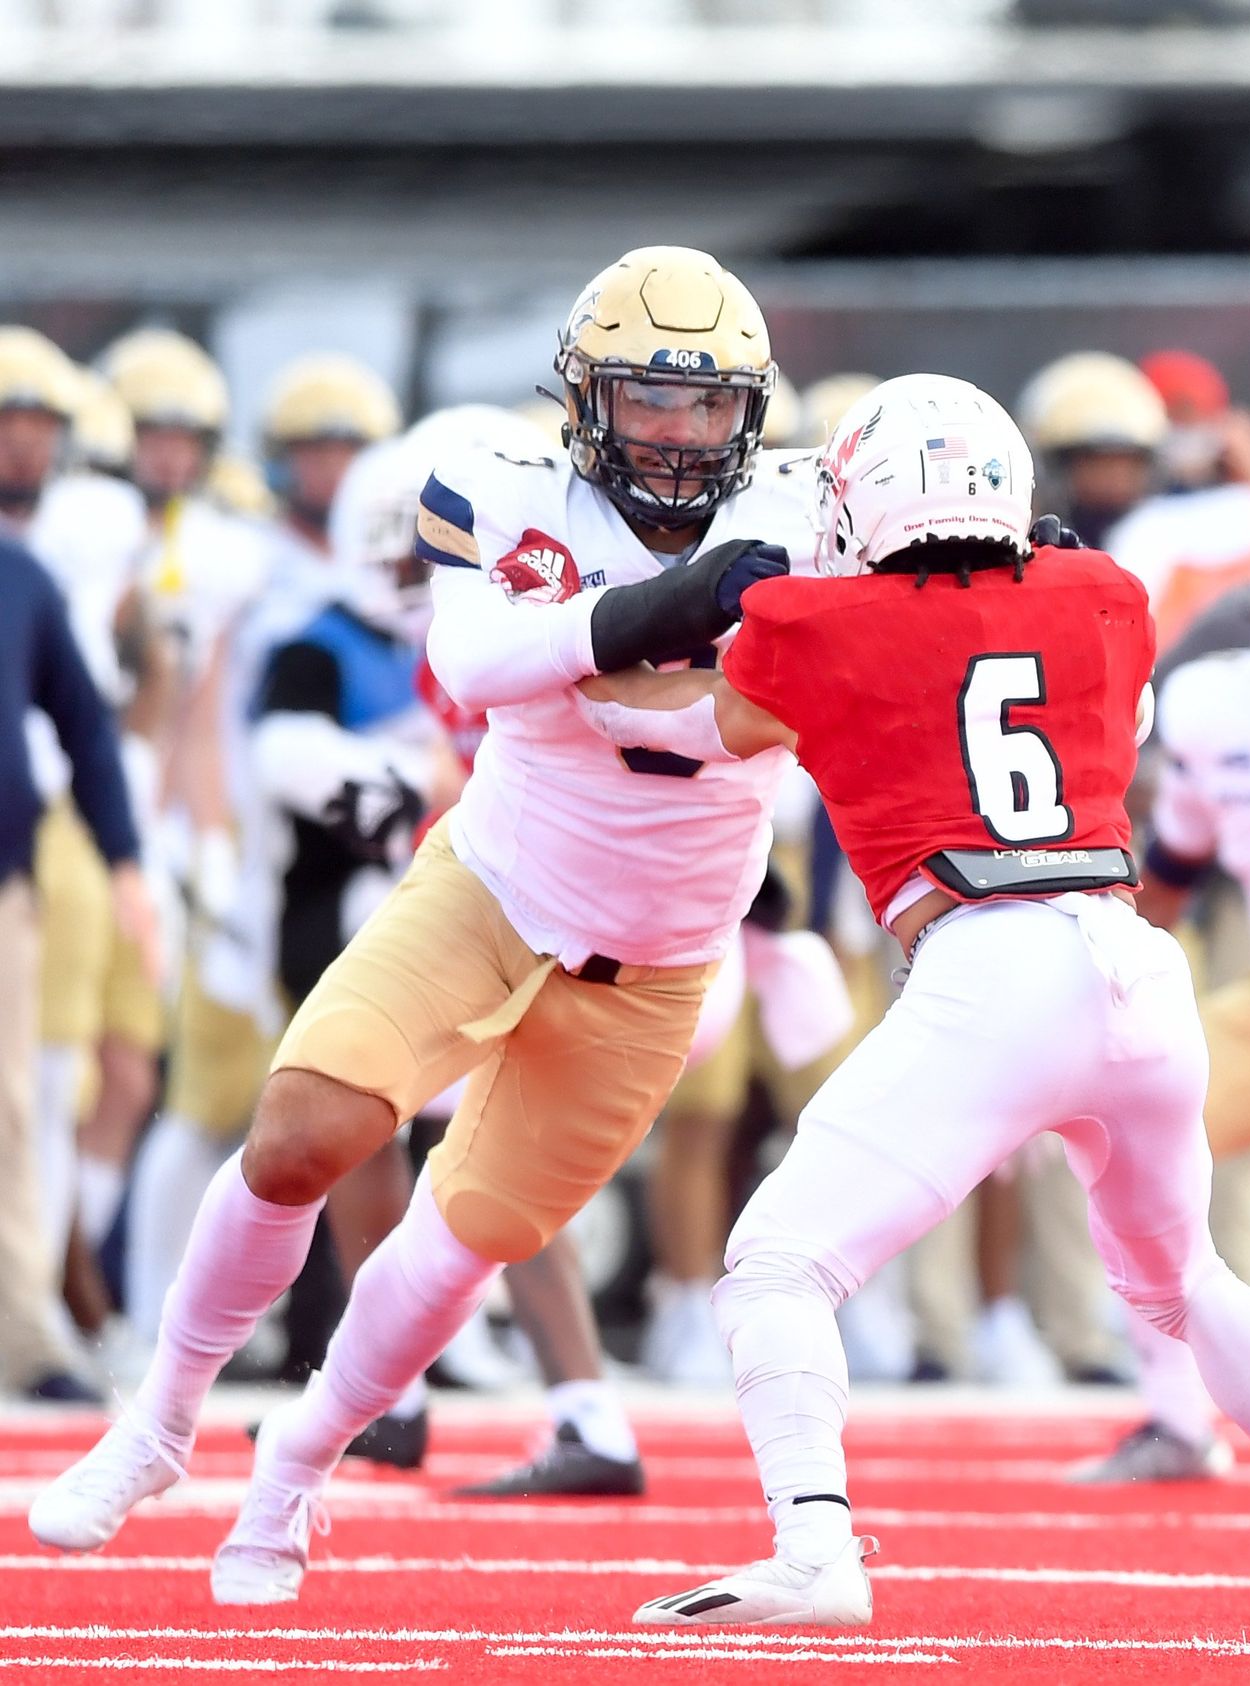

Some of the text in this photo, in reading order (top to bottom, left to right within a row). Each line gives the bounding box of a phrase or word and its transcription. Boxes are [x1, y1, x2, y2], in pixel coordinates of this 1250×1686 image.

[666, 349, 702, 369] 406
[968, 482, 976, 496] 6
[904, 522, 925, 533] One
[928, 515, 965, 526] Family
[957, 652, 1075, 847] 6
[1020, 850, 1092, 867] GEAR
